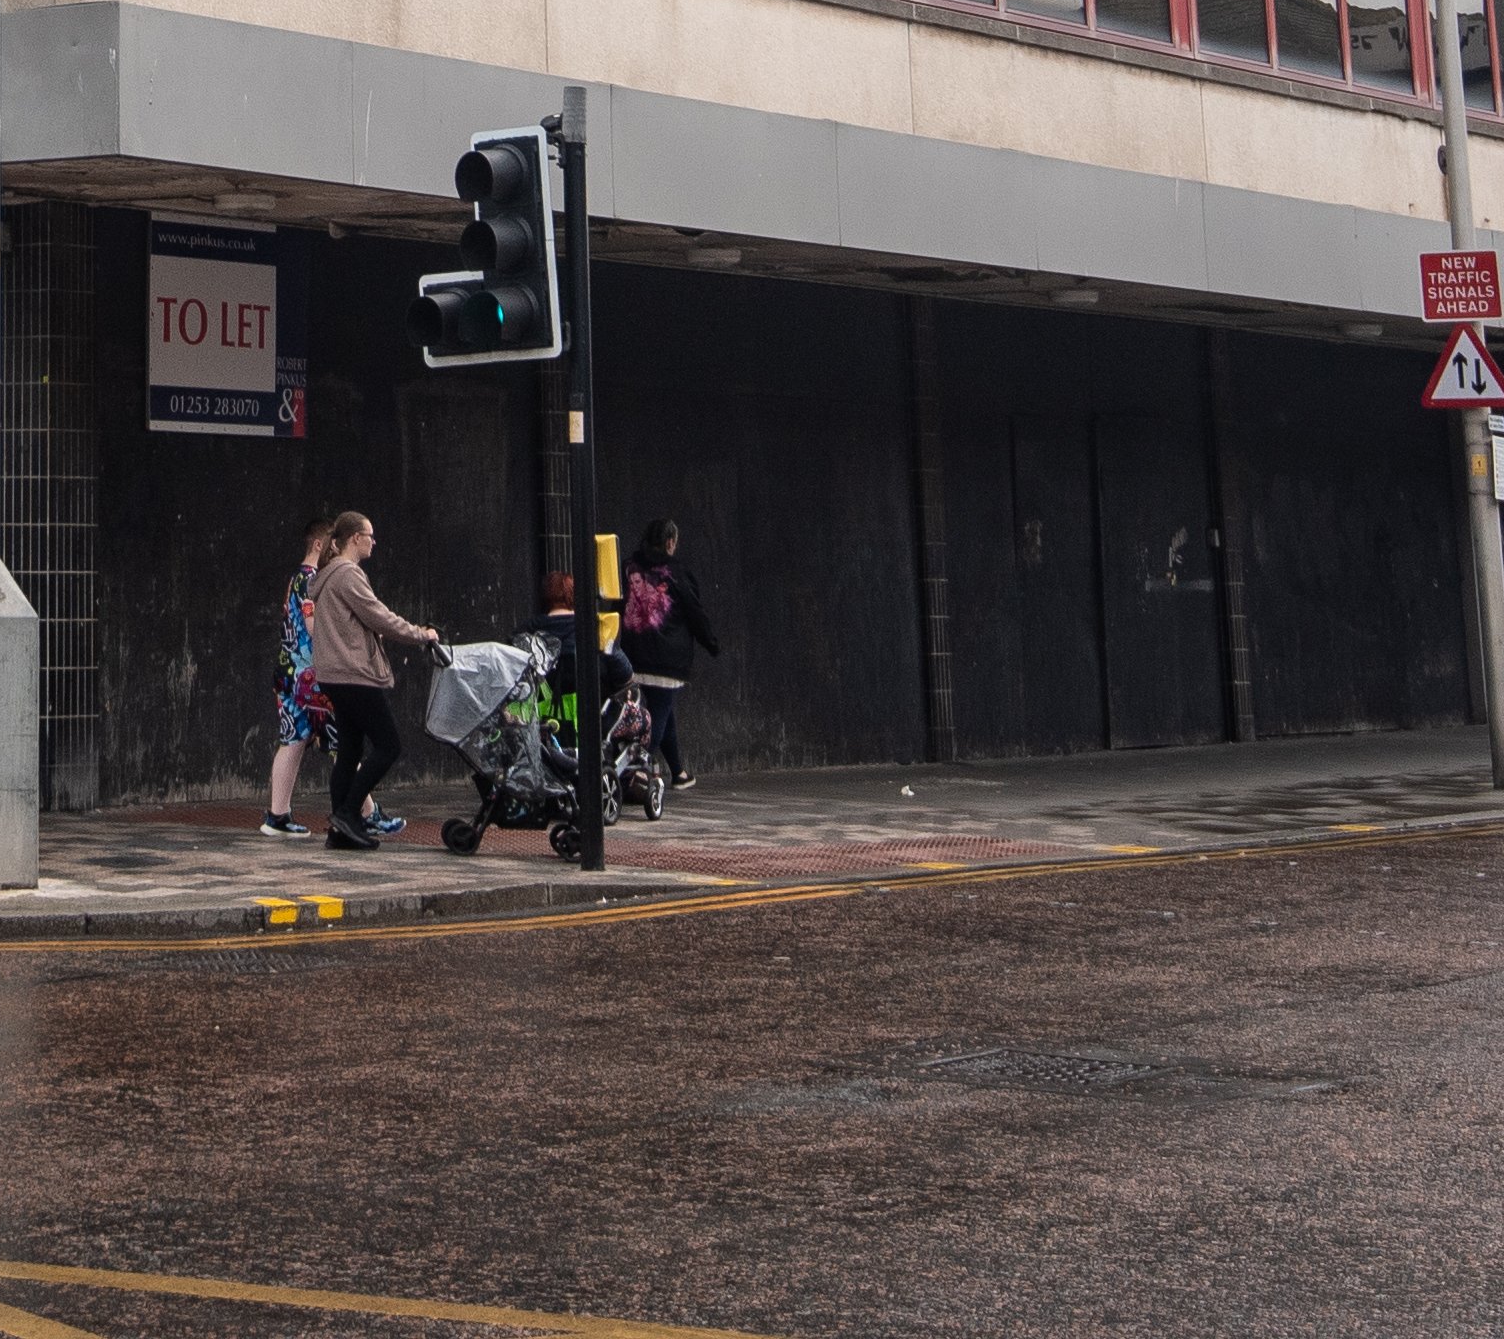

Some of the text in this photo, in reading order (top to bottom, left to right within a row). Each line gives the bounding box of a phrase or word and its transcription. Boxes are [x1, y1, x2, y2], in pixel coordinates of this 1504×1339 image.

[158, 232, 256, 252] www.pinkus.co.uk
[1441, 256, 1477, 270] NEW
[1427, 270, 1491, 284] TRAFFIC
[1427, 285, 1495, 300] SIGNALS
[1436, 300, 1489, 314] AHEAD
[156, 297, 271, 349] TO LET
[276, 357, 307, 371] ROBERT
[276, 373, 307, 388] PINKUS
[170, 395, 259, 417] 01253 283070
[278, 388, 298, 423] &
